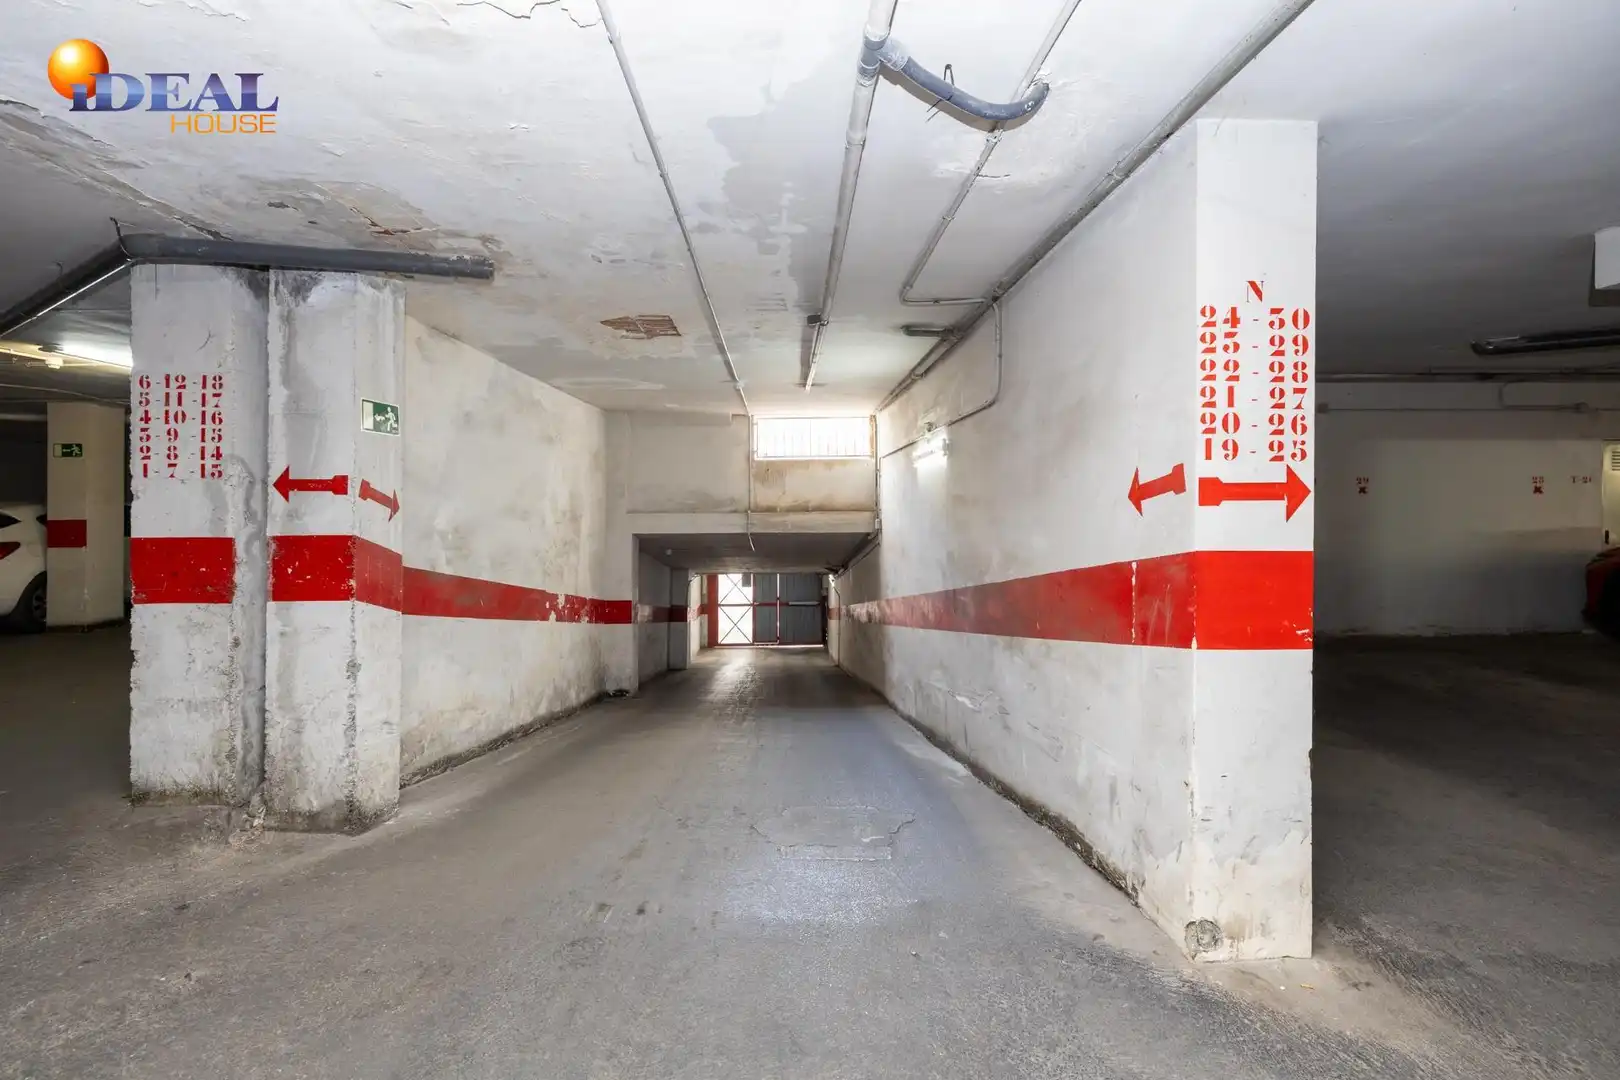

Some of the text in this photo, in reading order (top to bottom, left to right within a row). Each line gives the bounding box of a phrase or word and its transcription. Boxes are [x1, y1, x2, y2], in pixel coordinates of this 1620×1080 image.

[1246, 280, 1265, 303] N
[1200, 305, 1241, 329] 24
[1268, 307, 1310, 331] 30
[1200, 331, 1241, 354] 23
[1268, 334, 1309, 357] 29
[1200, 358, 1241, 382] 22
[1268, 360, 1309, 384] 28
[1200, 385, 1235, 408] 21
[1268, 386, 1307, 410] 27
[1200, 412, 1241, 435] 20
[1268, 413, 1308, 436] 26
[1204, 437, 1239, 461] 19
[1268, 440, 1308, 462] 25
